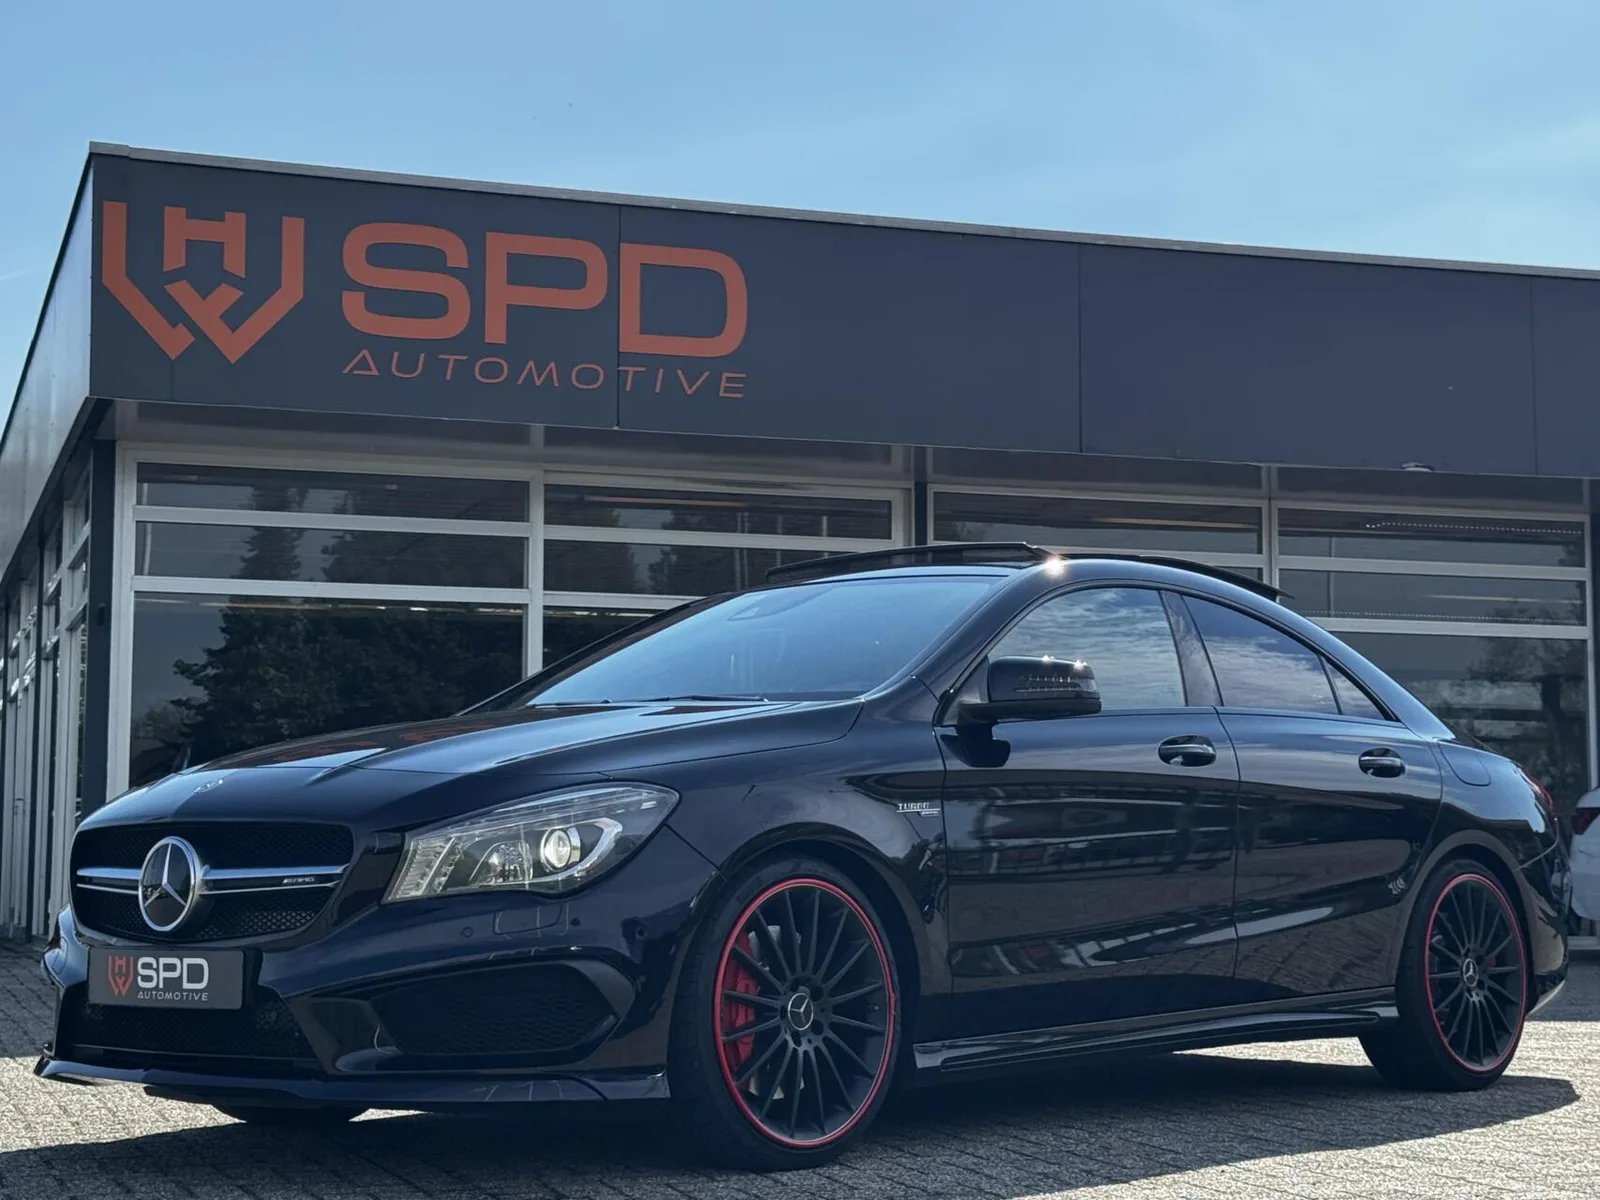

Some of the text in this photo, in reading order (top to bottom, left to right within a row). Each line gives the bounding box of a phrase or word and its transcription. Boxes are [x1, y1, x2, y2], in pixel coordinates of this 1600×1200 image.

[342, 222, 747, 357] SPD
[342, 348, 747, 398] AUTOMOTIVE
[137, 956, 209, 989] SPD
[137, 991, 209, 1001] AUTOMOTIVE
